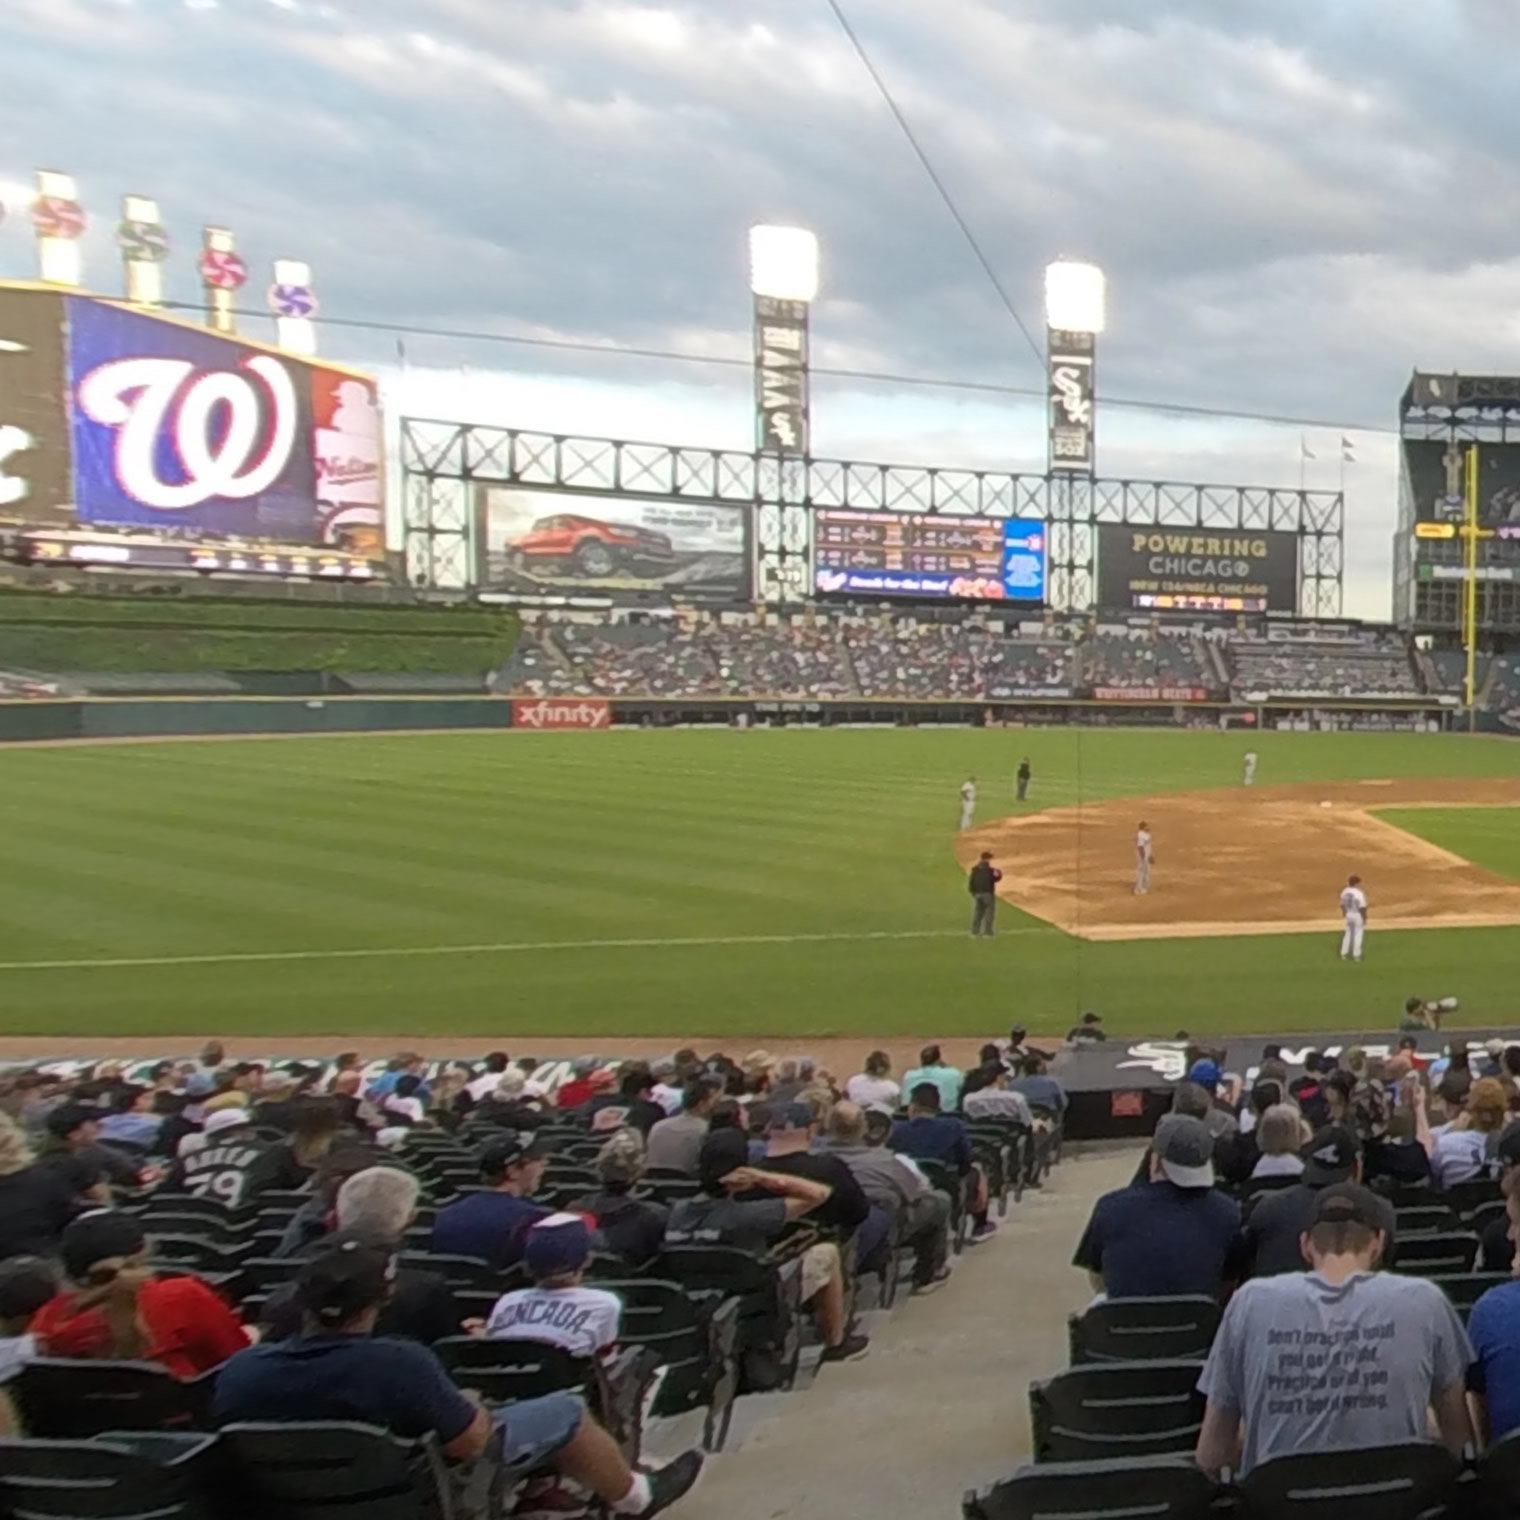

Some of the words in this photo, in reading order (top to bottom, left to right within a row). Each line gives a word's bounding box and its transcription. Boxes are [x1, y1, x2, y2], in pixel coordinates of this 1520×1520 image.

[79, 355, 298, 510] W
[1132, 534, 1268, 557] POWERING
[518, 701, 608, 728] xfinity
